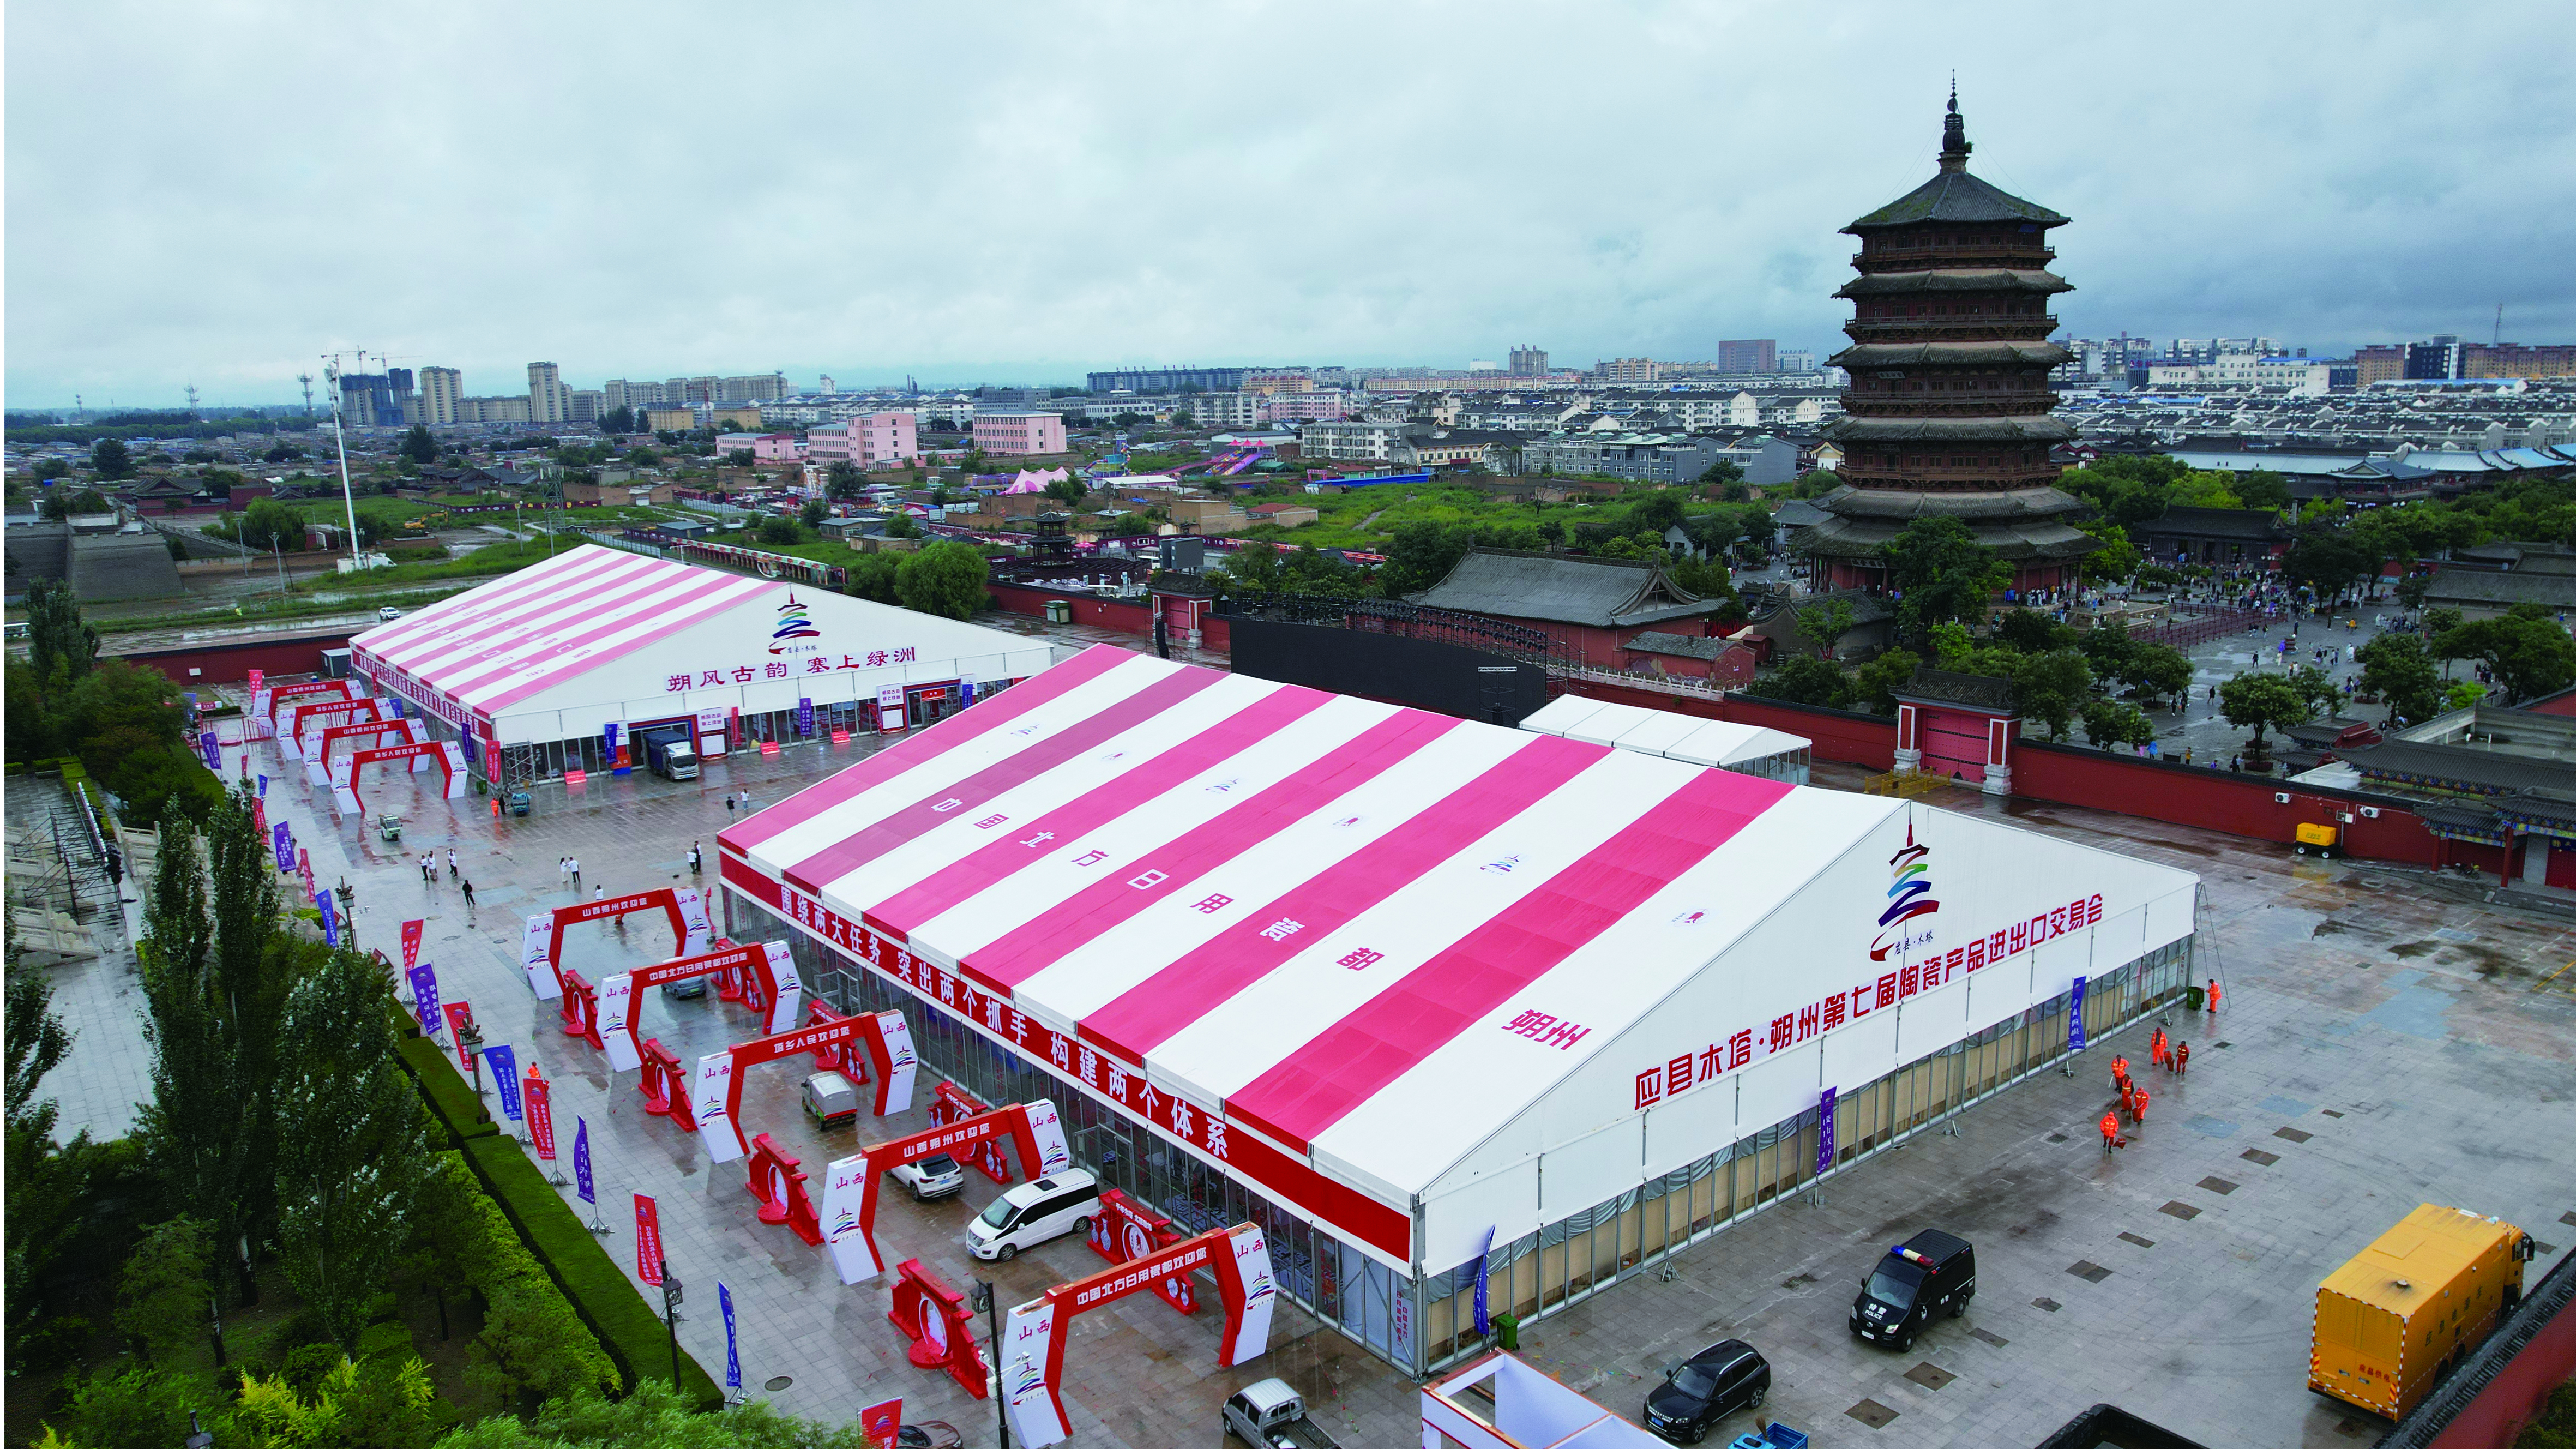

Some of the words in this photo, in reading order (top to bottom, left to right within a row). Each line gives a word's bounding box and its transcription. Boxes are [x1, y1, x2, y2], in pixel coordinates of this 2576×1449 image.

[667, 662, 787, 692] 朔风古韵
[806, 646, 916, 674] 塞上绿洲
[582, 897, 648, 917] 山西朔州欢迎您
[677, 894, 697, 905] 山西
[531, 923, 552, 934] 山西
[768, 950, 790, 962] 山西
[649, 952, 748, 981] 中国北方日用瓷都欢迎您
[606, 985, 630, 997] 山西
[1634, 893, 2103, 1110] 应县木塔·朔州第七届陶瓷产品进出口交易会
[781, 886, 882, 966] 围绕两大任务
[898, 950, 1028, 1045] 突出两个抓手
[1050, 1032, 1229, 1159] 构建两个体系
[883, 1021, 906, 1036] 山西
[1501, 1008, 1593, 1051] 朔州
[773, 1026, 851, 1054] 塔乡人民欢迎您
[704, 1064, 730, 1079] 山西
[1032, 1112, 1057, 1129] 山西
[903, 1122, 990, 1158] 山西朔州欢迎您
[835, 1172, 864, 1190] 山西
[1237, 1238, 1264, 1259] 山西
[1076, 1246, 1208, 1306] 中国北方日用瓷都欢迎您
[1864, 1309, 1883, 1320] POLICE
[1869, 1303, 1887, 1315] 特警
[1019, 1319, 1050, 1342] 山西
